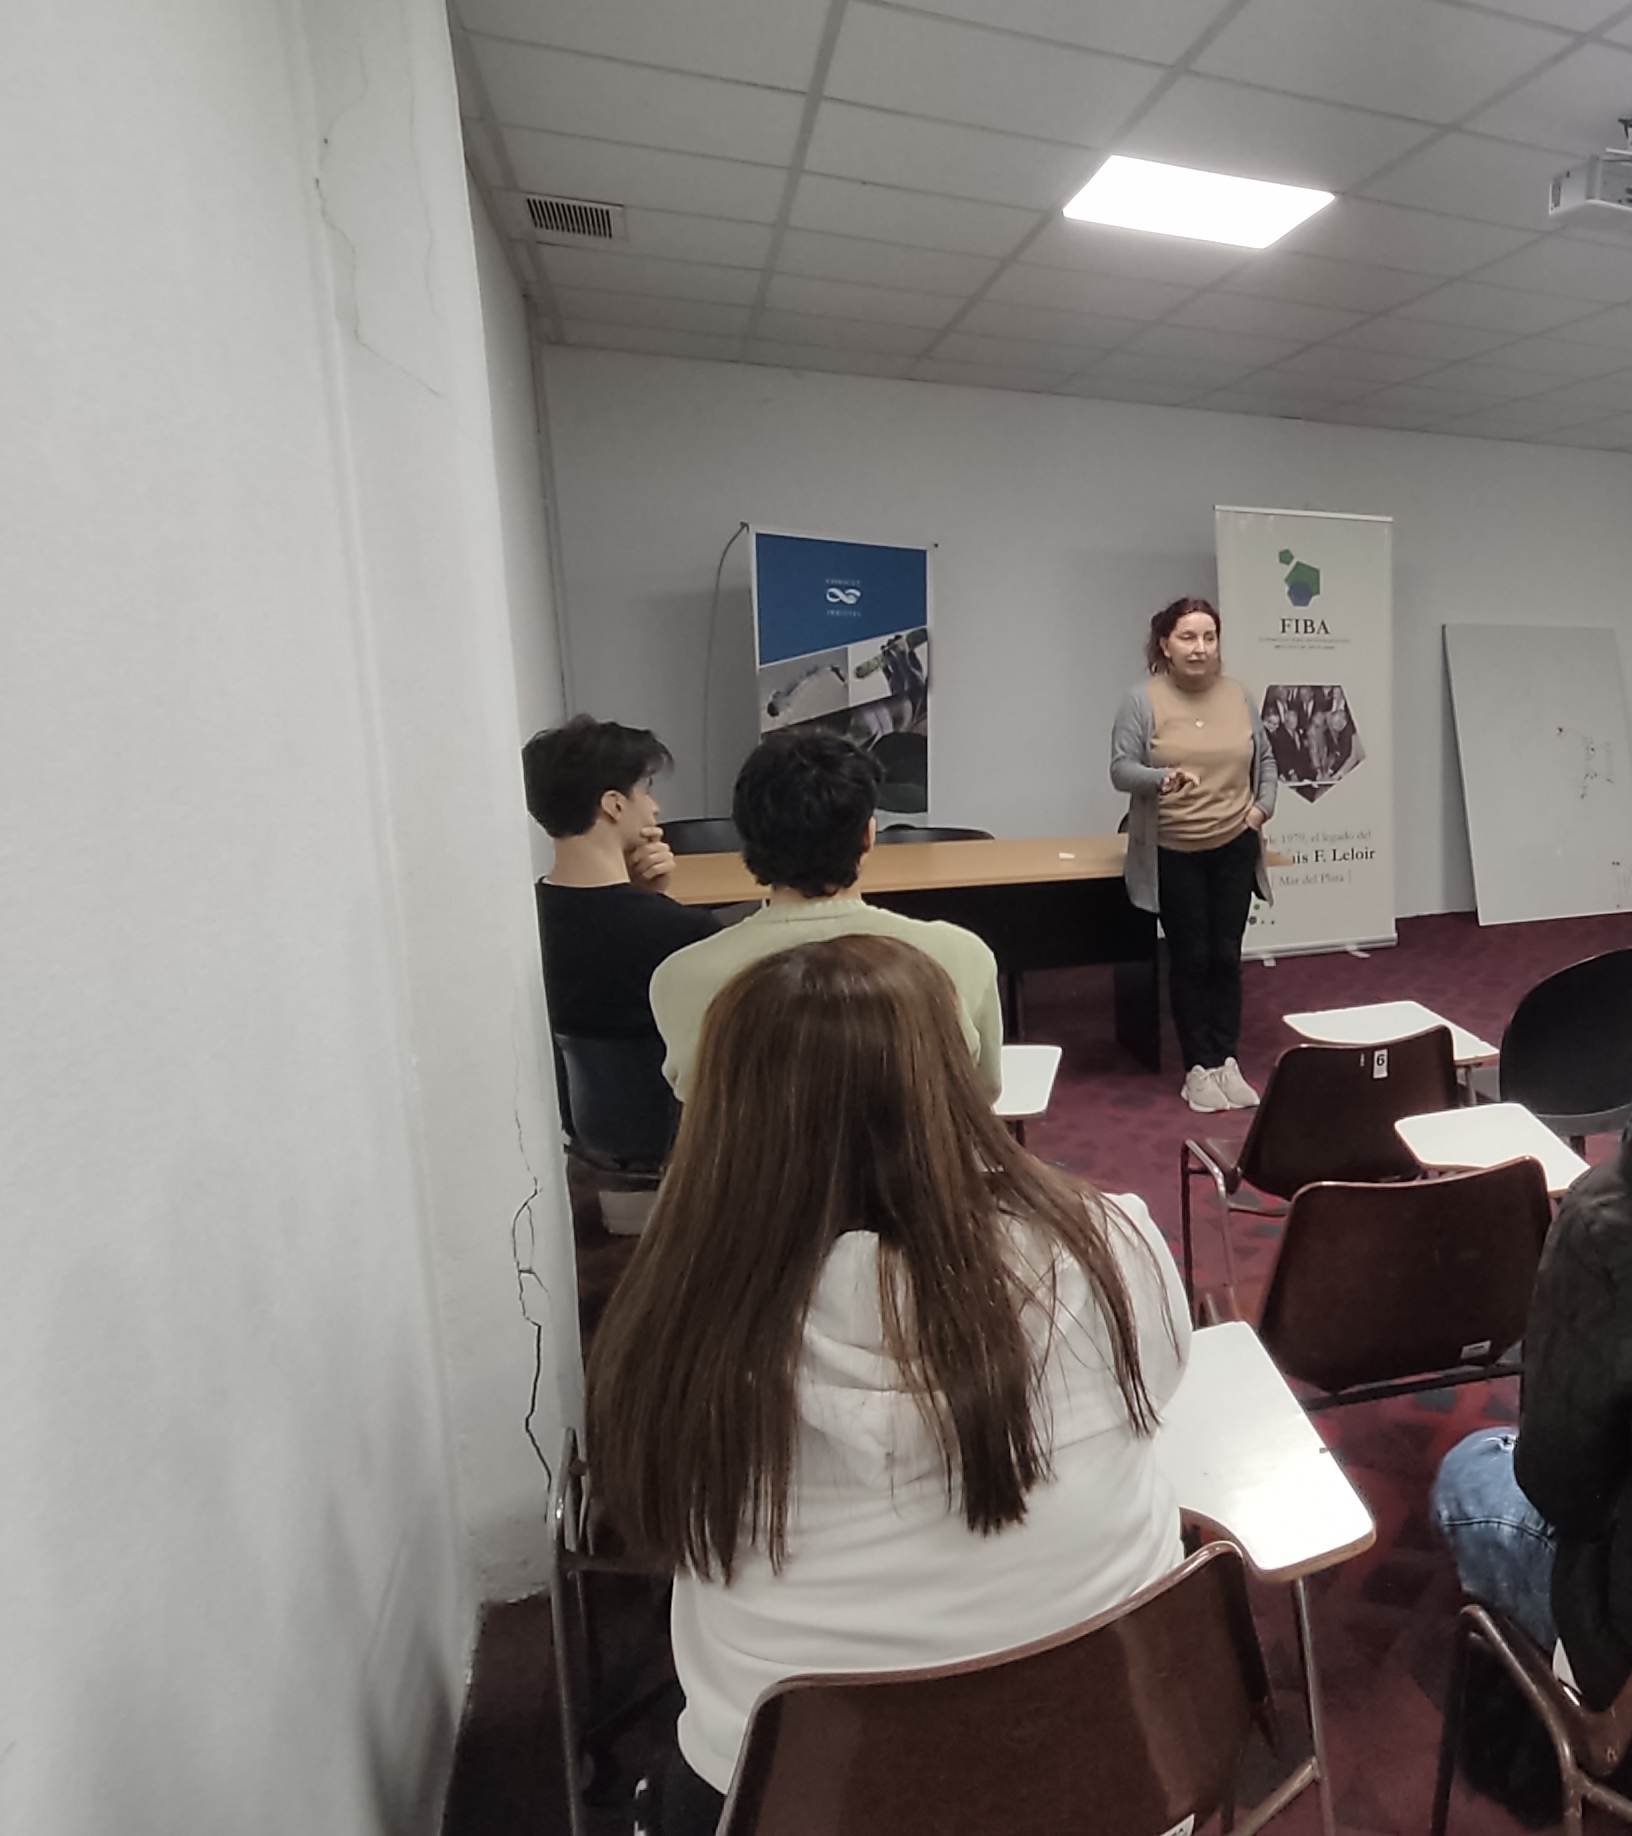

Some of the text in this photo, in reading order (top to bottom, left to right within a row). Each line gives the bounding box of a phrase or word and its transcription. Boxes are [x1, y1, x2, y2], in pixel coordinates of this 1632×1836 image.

[1280, 618, 1330, 635] FIBA
[1314, 849, 1326, 863] F.
[1332, 846, 1376, 862] Leloir
[1376, 1054, 1385, 1067] 6
